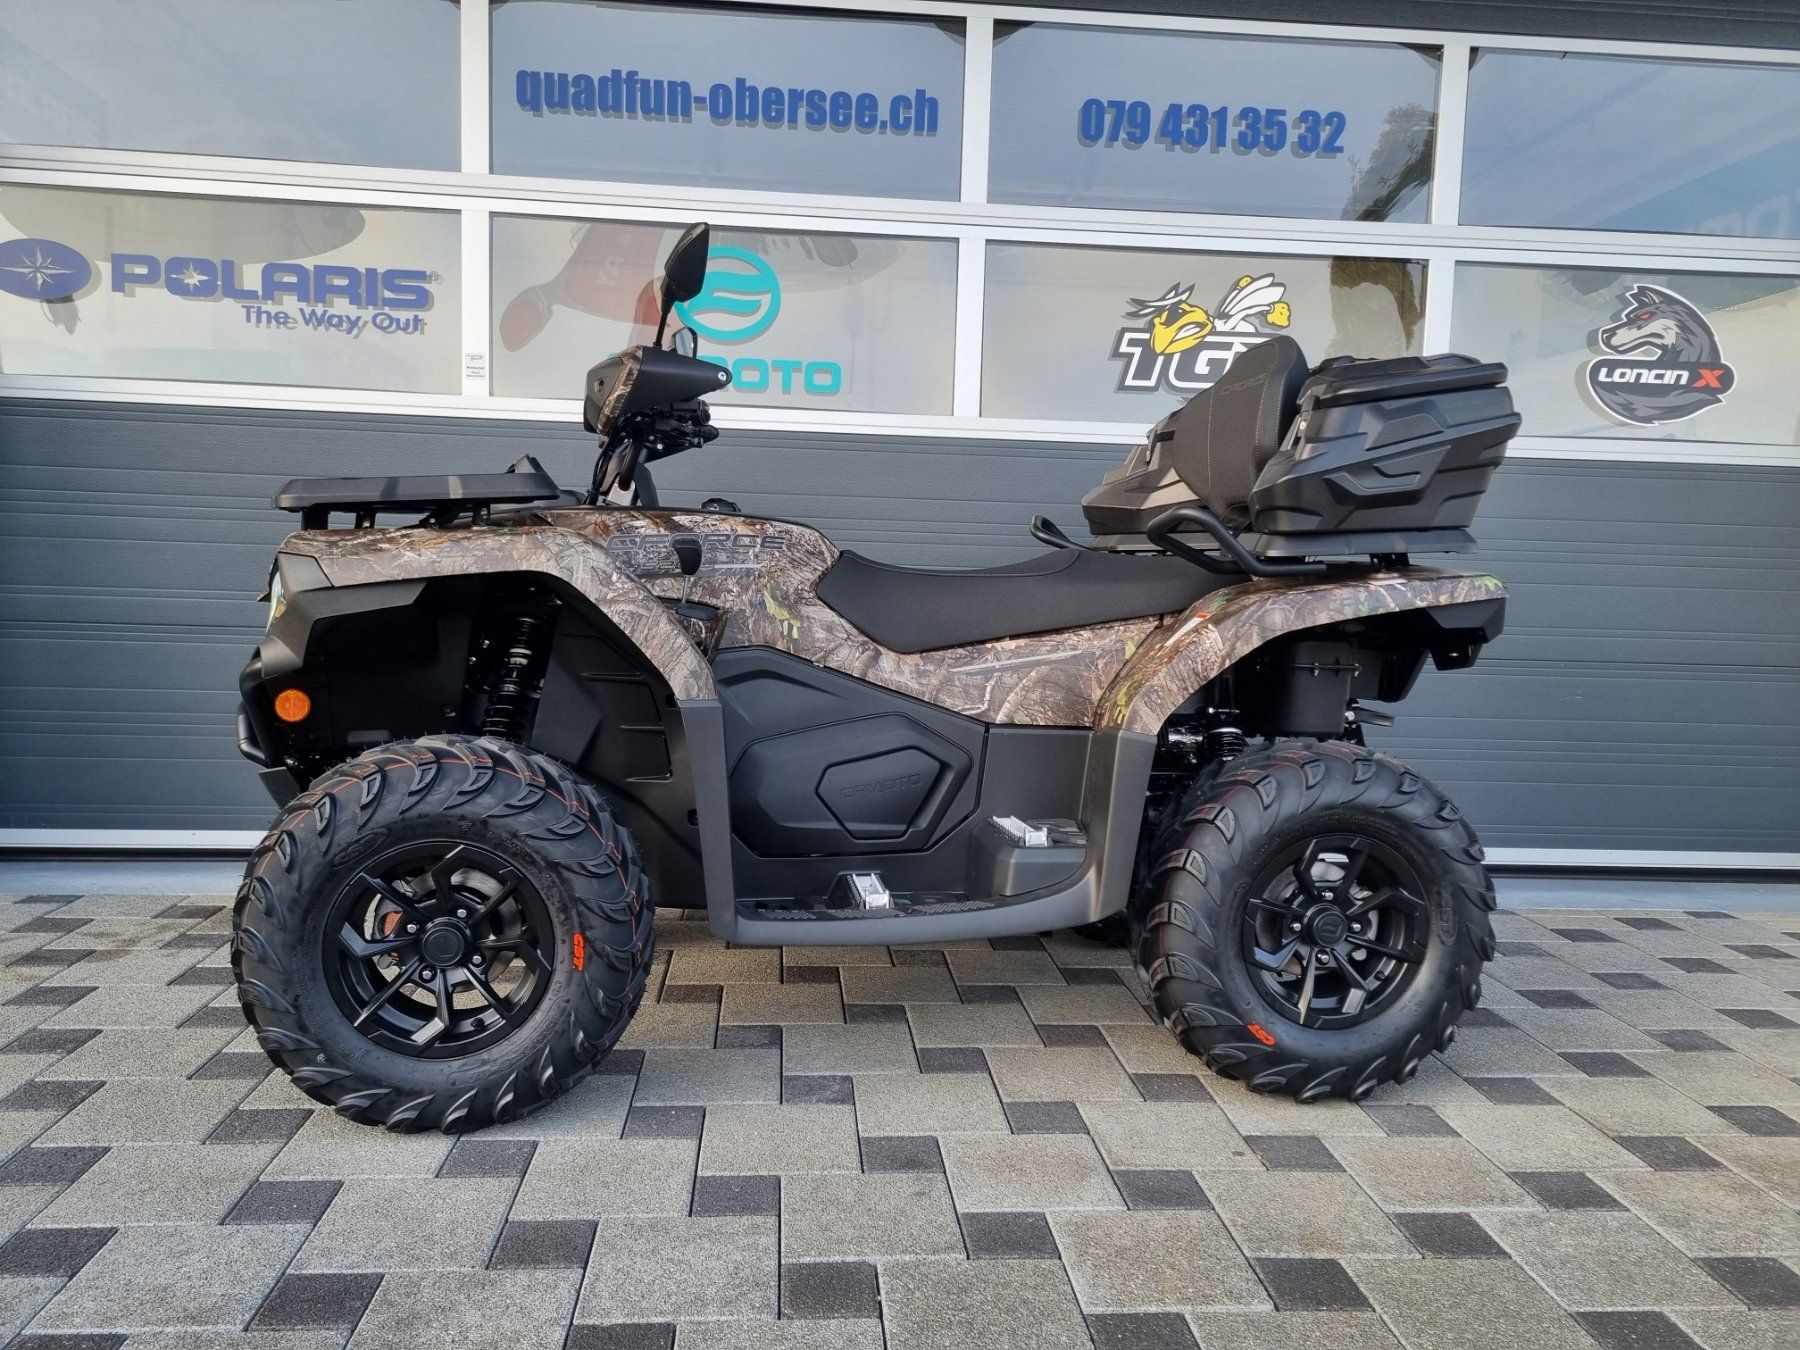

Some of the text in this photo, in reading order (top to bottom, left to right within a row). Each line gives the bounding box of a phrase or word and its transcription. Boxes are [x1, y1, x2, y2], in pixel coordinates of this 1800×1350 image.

[515, 68, 938, 133] quadfun-obersee.ch
[1081, 98, 1346, 154] 079 431 35 32
[241, 304, 423, 335] The Way Out
[1112, 326, 1272, 392] TG
[1597, 367, 1726, 389] LONCIN X
